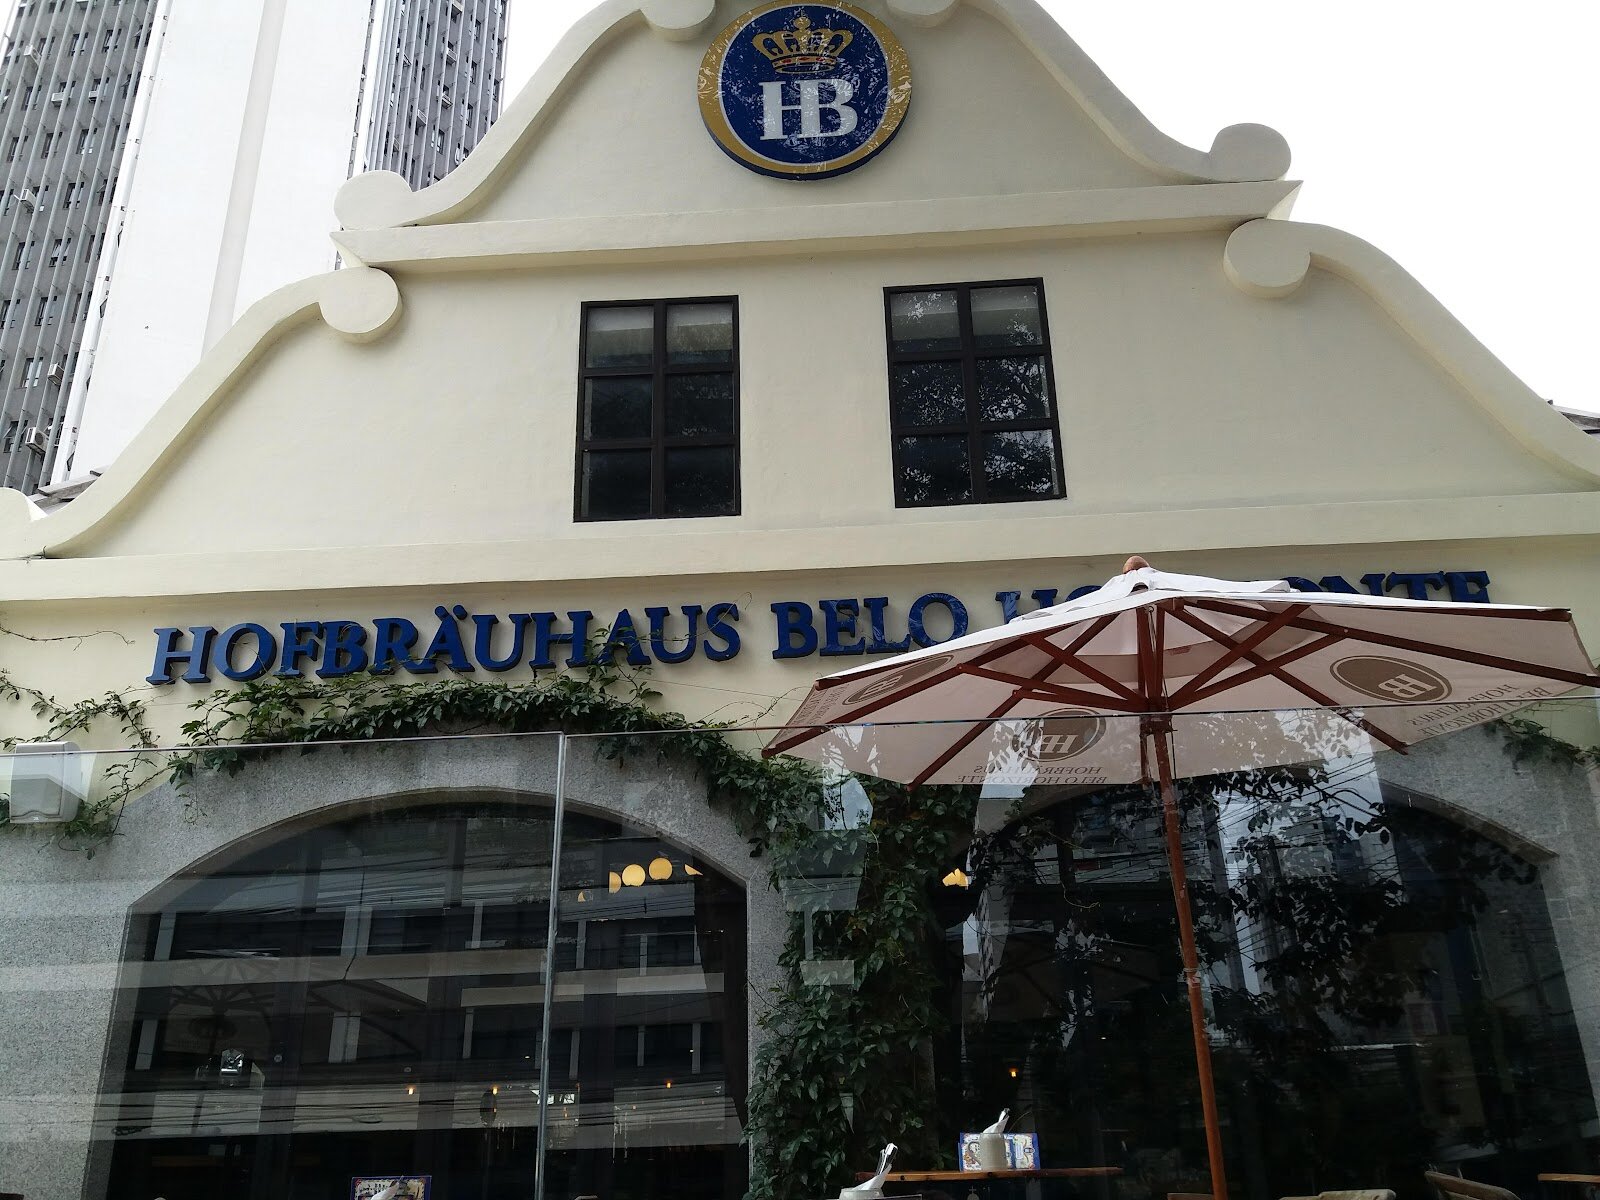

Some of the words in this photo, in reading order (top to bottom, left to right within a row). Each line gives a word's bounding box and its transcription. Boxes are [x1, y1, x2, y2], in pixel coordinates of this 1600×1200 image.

[758, 78, 858, 141] HB
[146, 604, 740, 685] HOFBRÄUHAUS
[772, 592, 969, 660] BELO
